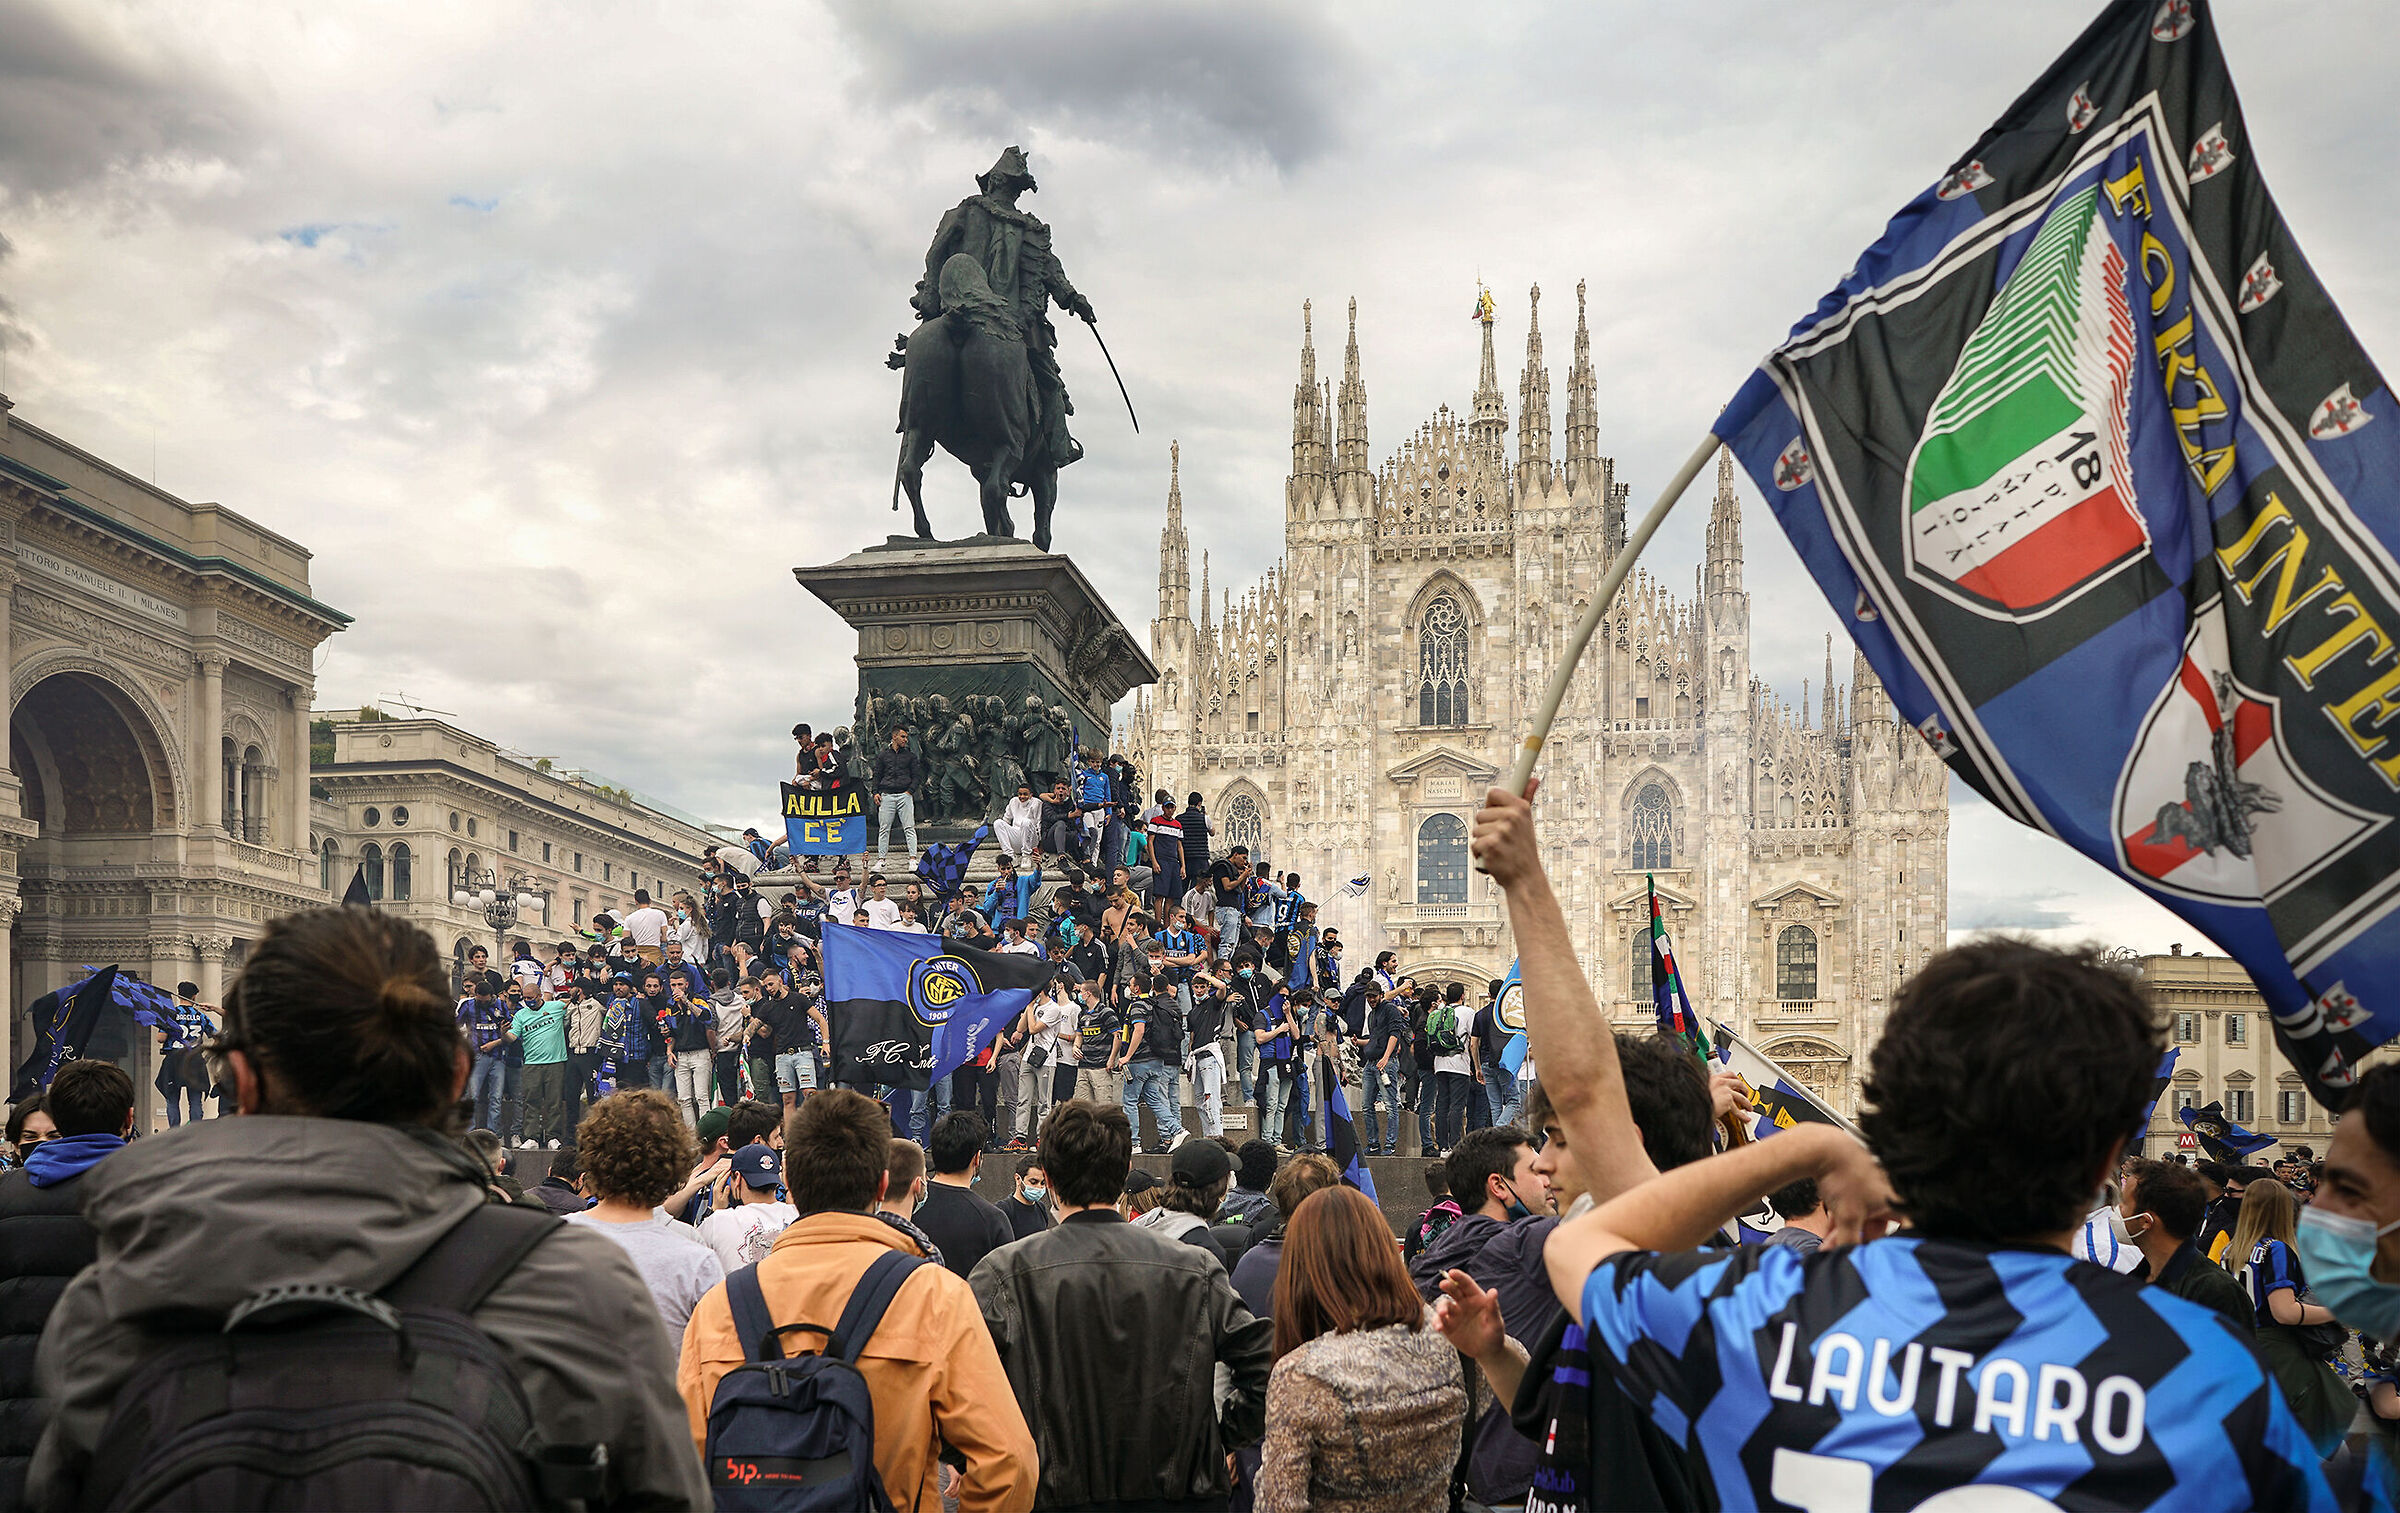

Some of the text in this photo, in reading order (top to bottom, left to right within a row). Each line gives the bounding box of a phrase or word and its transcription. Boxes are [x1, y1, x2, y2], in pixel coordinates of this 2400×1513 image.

[2055, 431, 2103, 490] 18
[15, 545, 60, 571] VITTORIO
[64, 566, 114, 594] EMANUELE
[141, 597, 179, 620] MILANESI
[2214, 490, 2400, 794] INTE
[786, 792, 862, 816] AULLA
[1278, 903, 1289, 922] 9
[928, 1011, 949, 1021] 1908
[2180, 1135, 2195, 1146] M
[1769, 1322, 2147, 1455] LAUTARO
